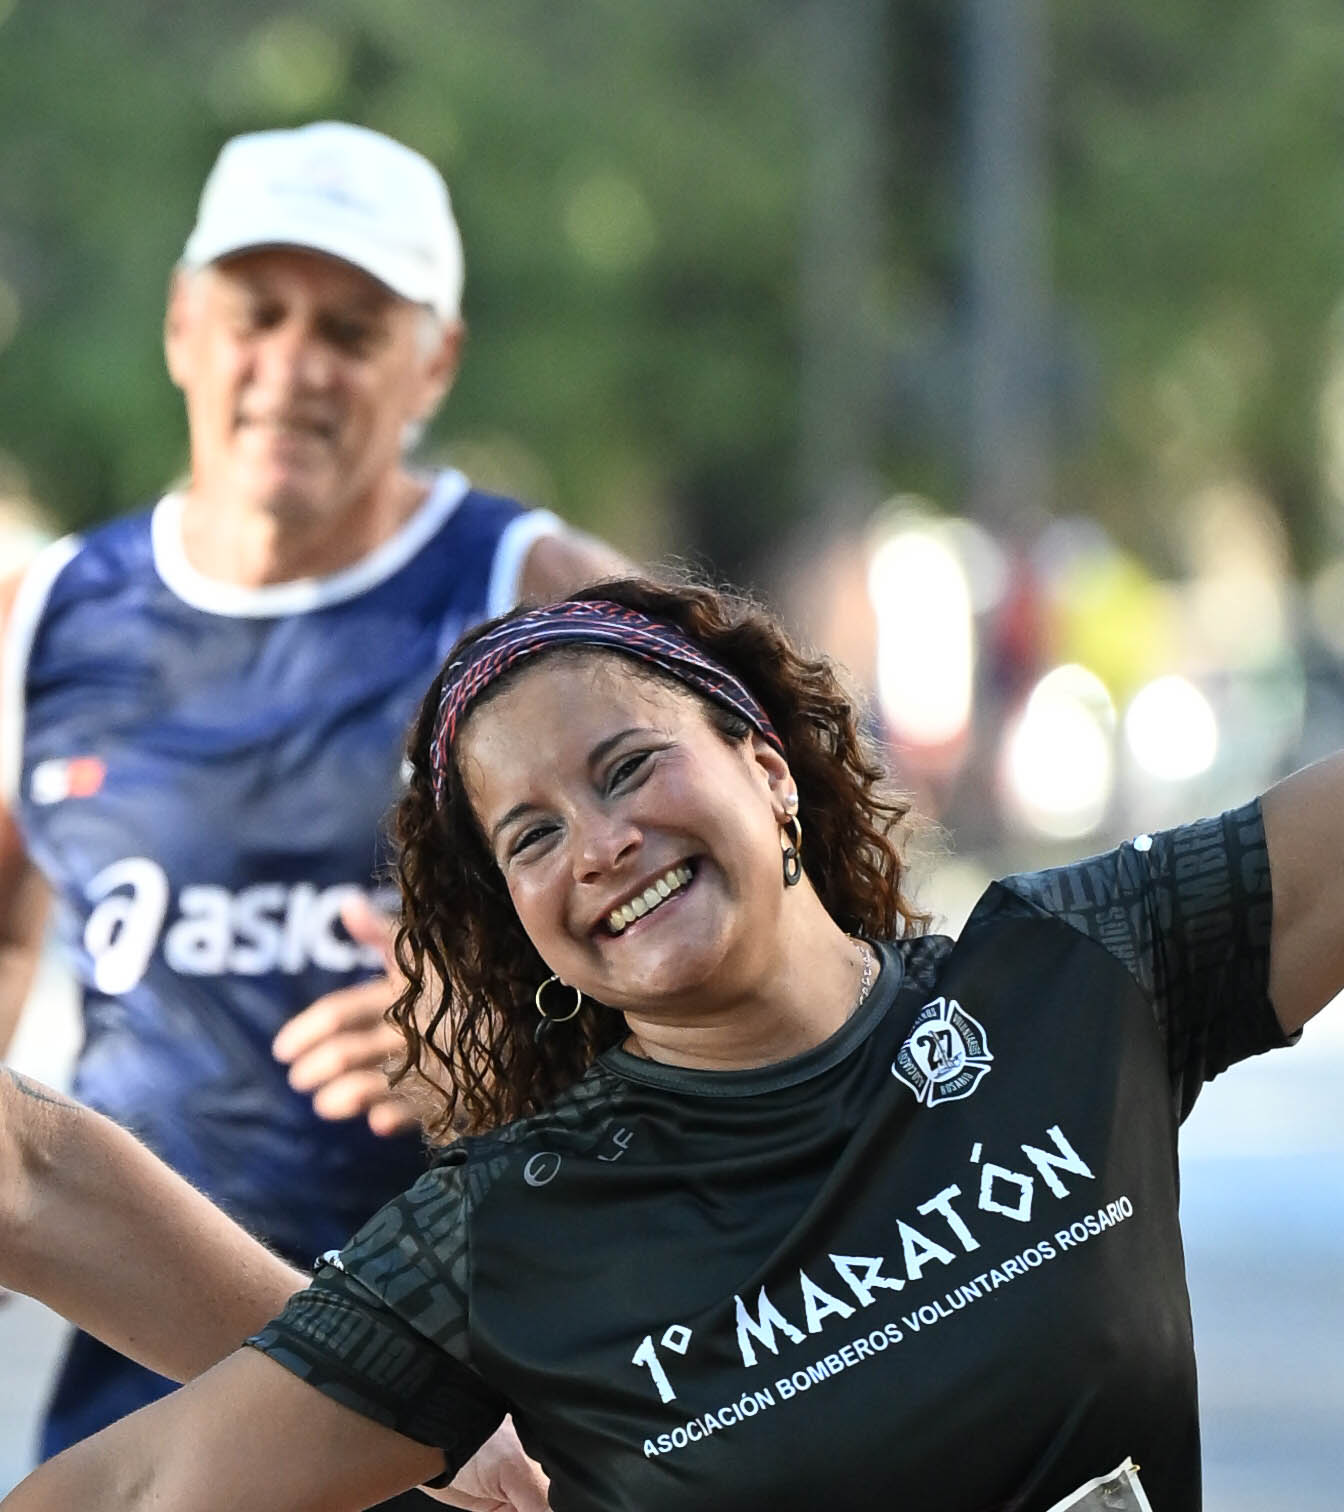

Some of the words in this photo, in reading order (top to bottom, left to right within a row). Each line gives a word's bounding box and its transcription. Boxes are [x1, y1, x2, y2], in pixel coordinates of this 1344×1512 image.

[916, 1029, 953, 1072] 27
[643, 1392, 776, 1458] ASOCIACIÓN
[775, 1323, 904, 1400] BOMBEROS
[902, 1241, 1056, 1331] VOLUNTARIOS
[1054, 1195, 1133, 1251] ROSARIO
[734, 1125, 1096, 1368] MARATÓN
